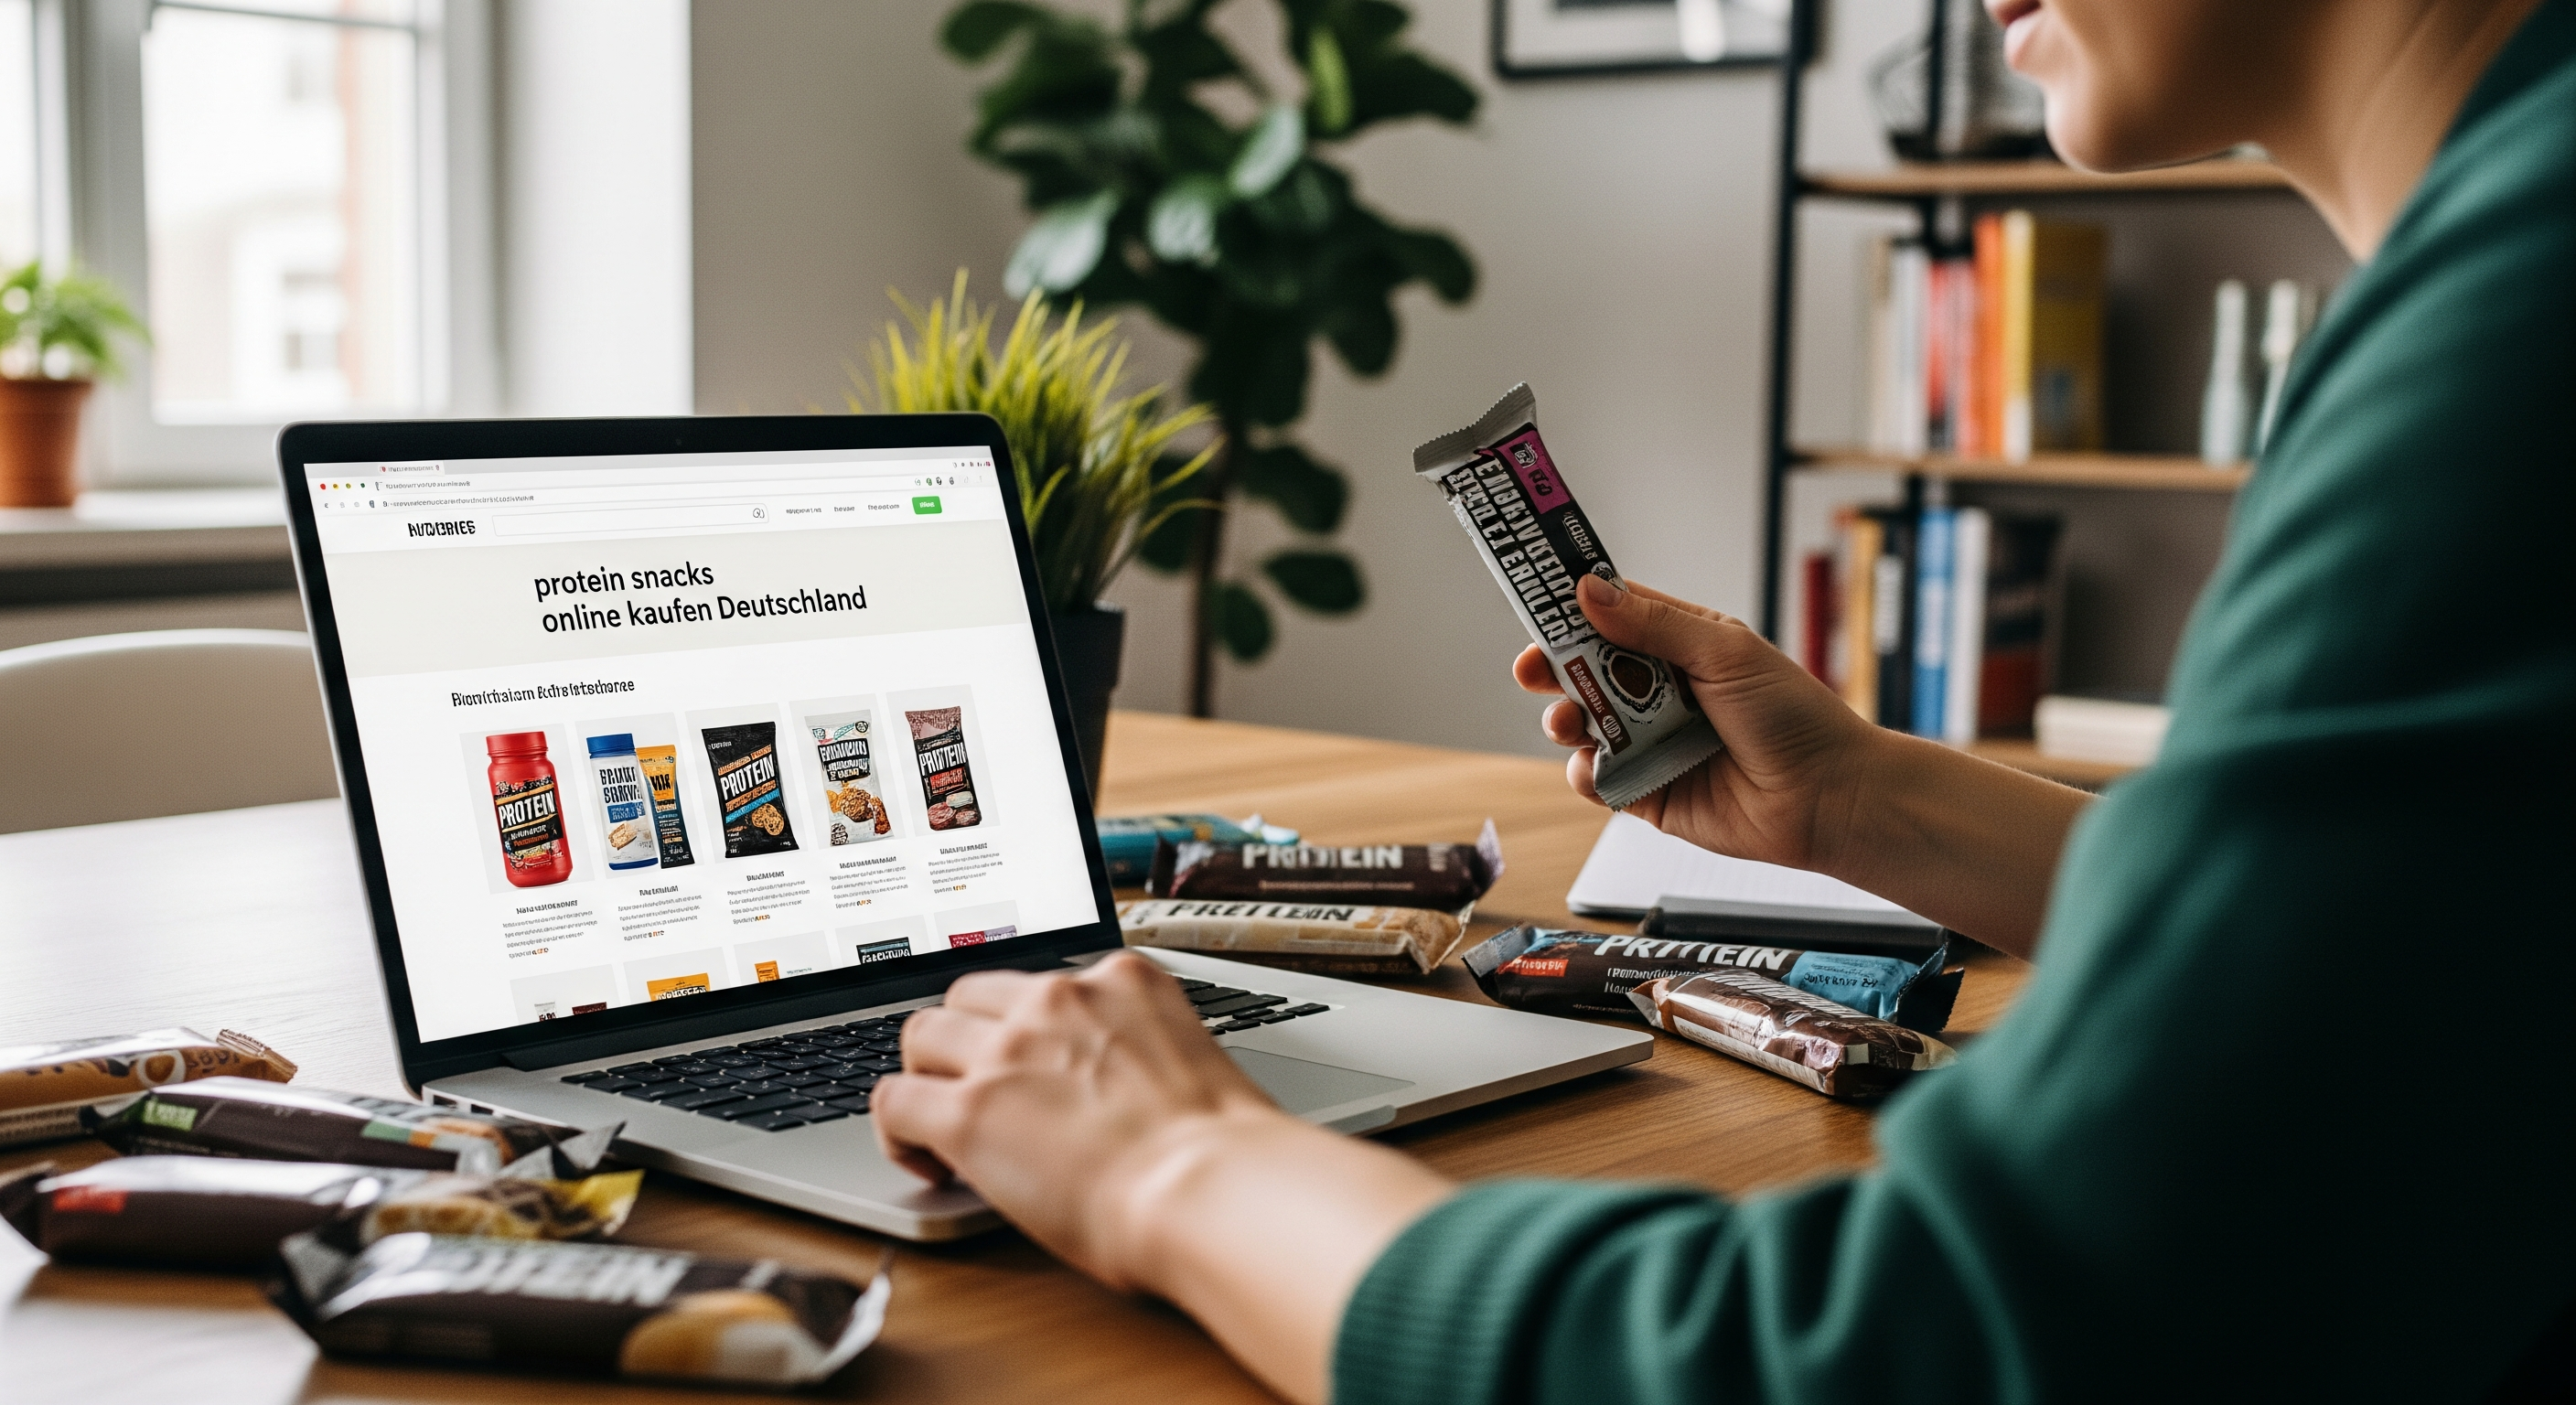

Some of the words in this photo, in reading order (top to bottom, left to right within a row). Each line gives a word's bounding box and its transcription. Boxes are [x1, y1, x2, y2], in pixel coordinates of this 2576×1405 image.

[534, 565, 626, 603] protein
[630, 561, 714, 590] snacks
[542, 603, 622, 633] online
[627, 597, 713, 627] kaufen
[716, 585, 868, 620] Deutschland
[720, 754, 776, 800] PROTEIN
[498, 790, 556, 828] PROTEIN
